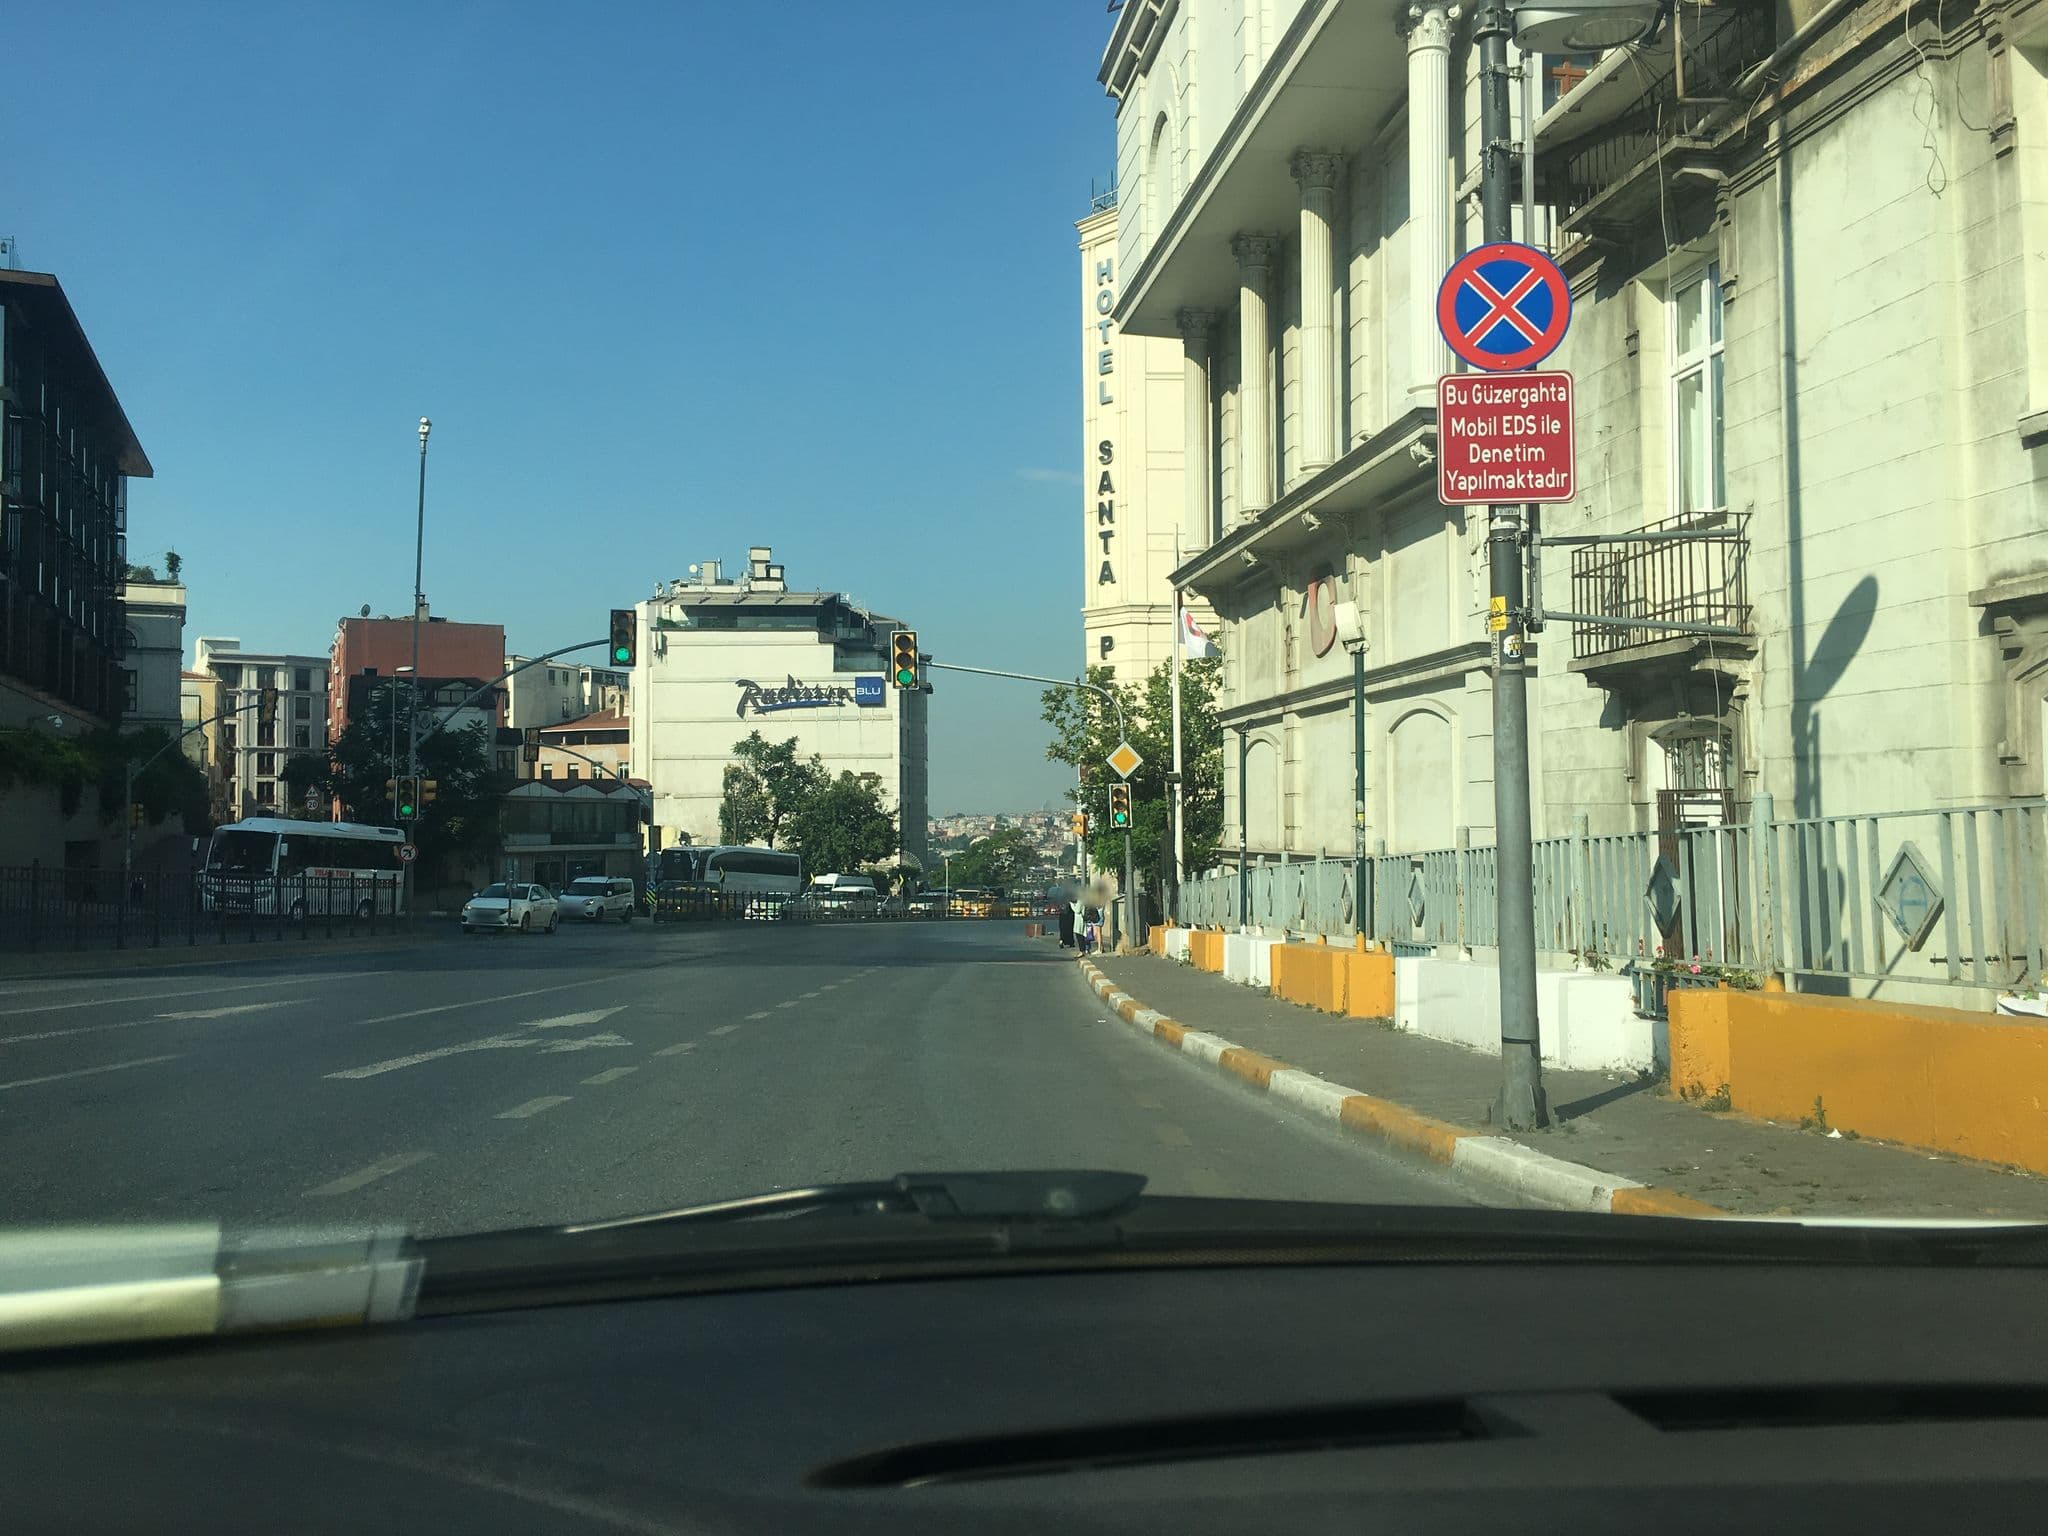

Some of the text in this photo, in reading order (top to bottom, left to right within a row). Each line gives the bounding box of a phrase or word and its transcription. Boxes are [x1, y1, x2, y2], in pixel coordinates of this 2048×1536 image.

[1096, 258, 1113, 405] HOTEL
[1446, 382, 1567, 408] Bu Güzergahta
[1451, 414, 1561, 437] Mobil EDS ile
[1469, 443, 1545, 463] Denetim
[1446, 467, 1568, 496] Yapılmaktadır
[1098, 440, 1116, 586] SANTA
[857, 687, 880, 695] BLU
[308, 801, 317, 809] 20
